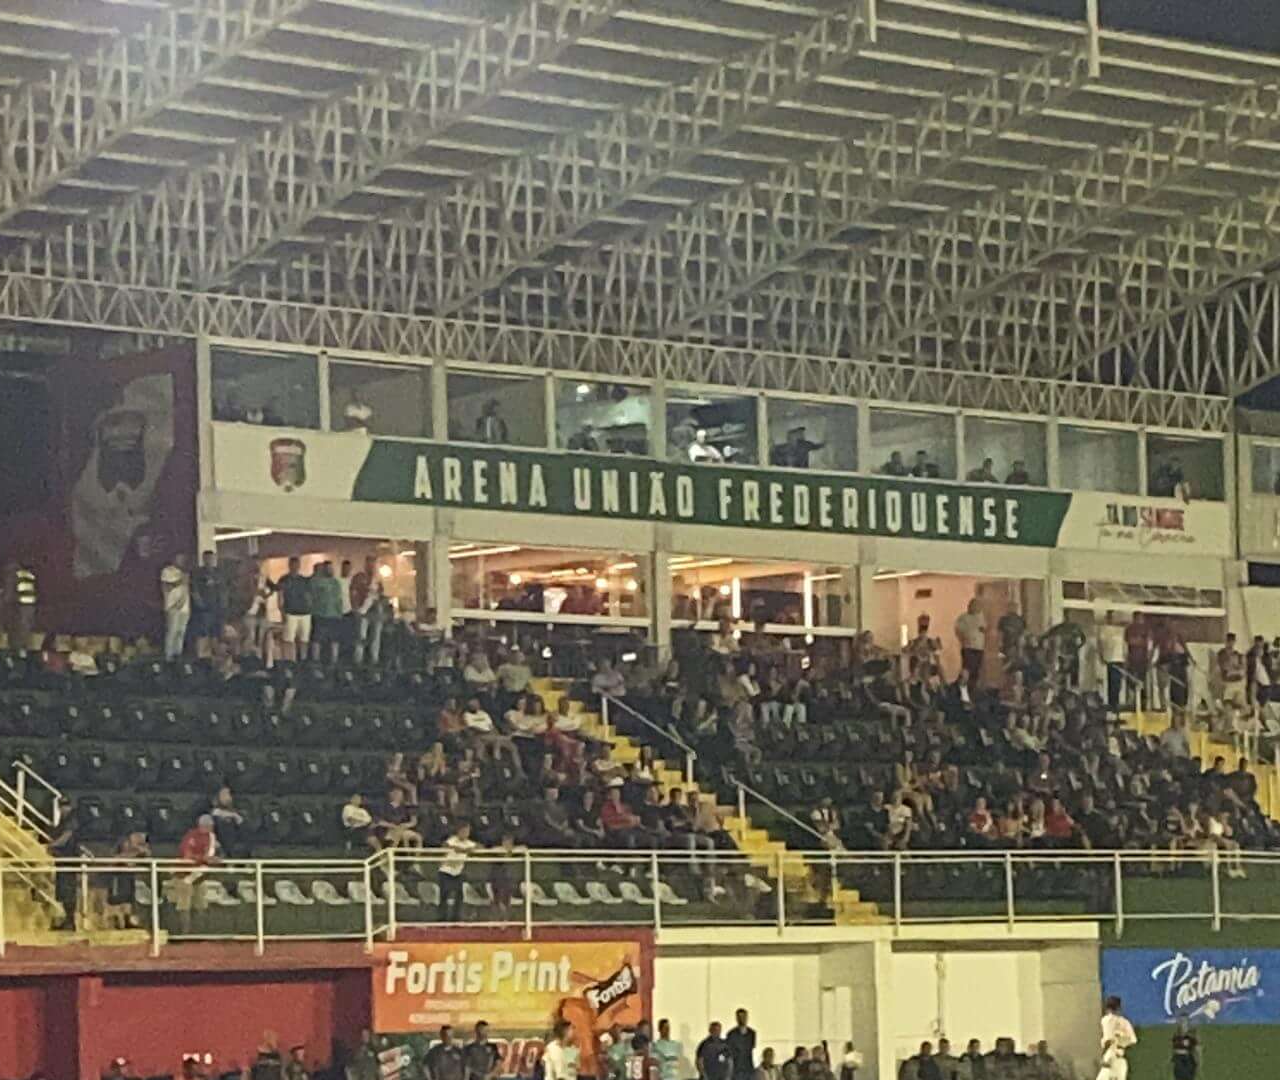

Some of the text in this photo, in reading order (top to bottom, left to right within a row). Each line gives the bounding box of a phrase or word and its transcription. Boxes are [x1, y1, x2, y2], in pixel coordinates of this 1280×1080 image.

[413, 455, 548, 508] ARENA
[573, 466, 695, 518] UNIÃO
[384, 949, 571, 995] Fortis Print
